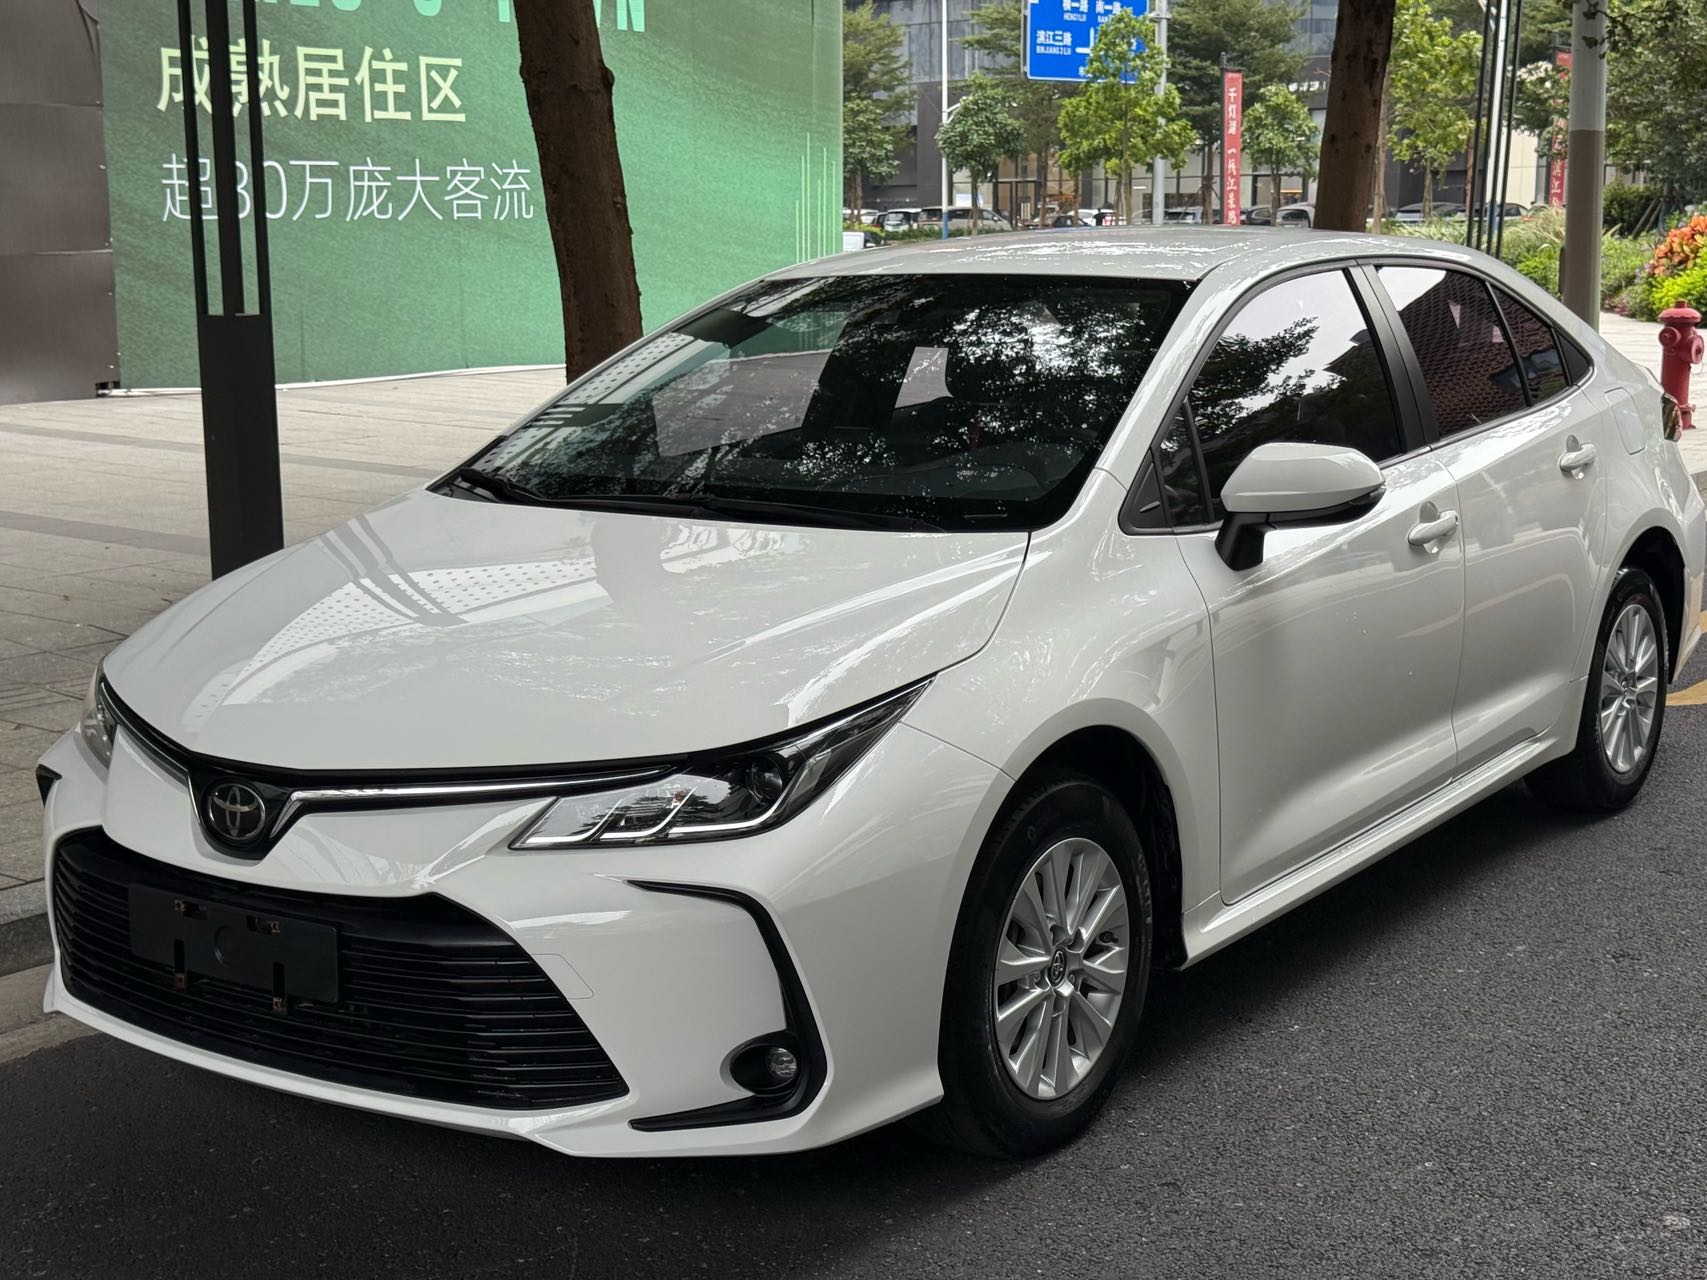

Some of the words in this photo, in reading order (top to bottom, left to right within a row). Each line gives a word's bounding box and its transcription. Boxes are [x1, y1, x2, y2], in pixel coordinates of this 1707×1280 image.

[1036, 30, 1072, 46] 滨江三路
[156, 35, 466, 123] 成熟居住区
